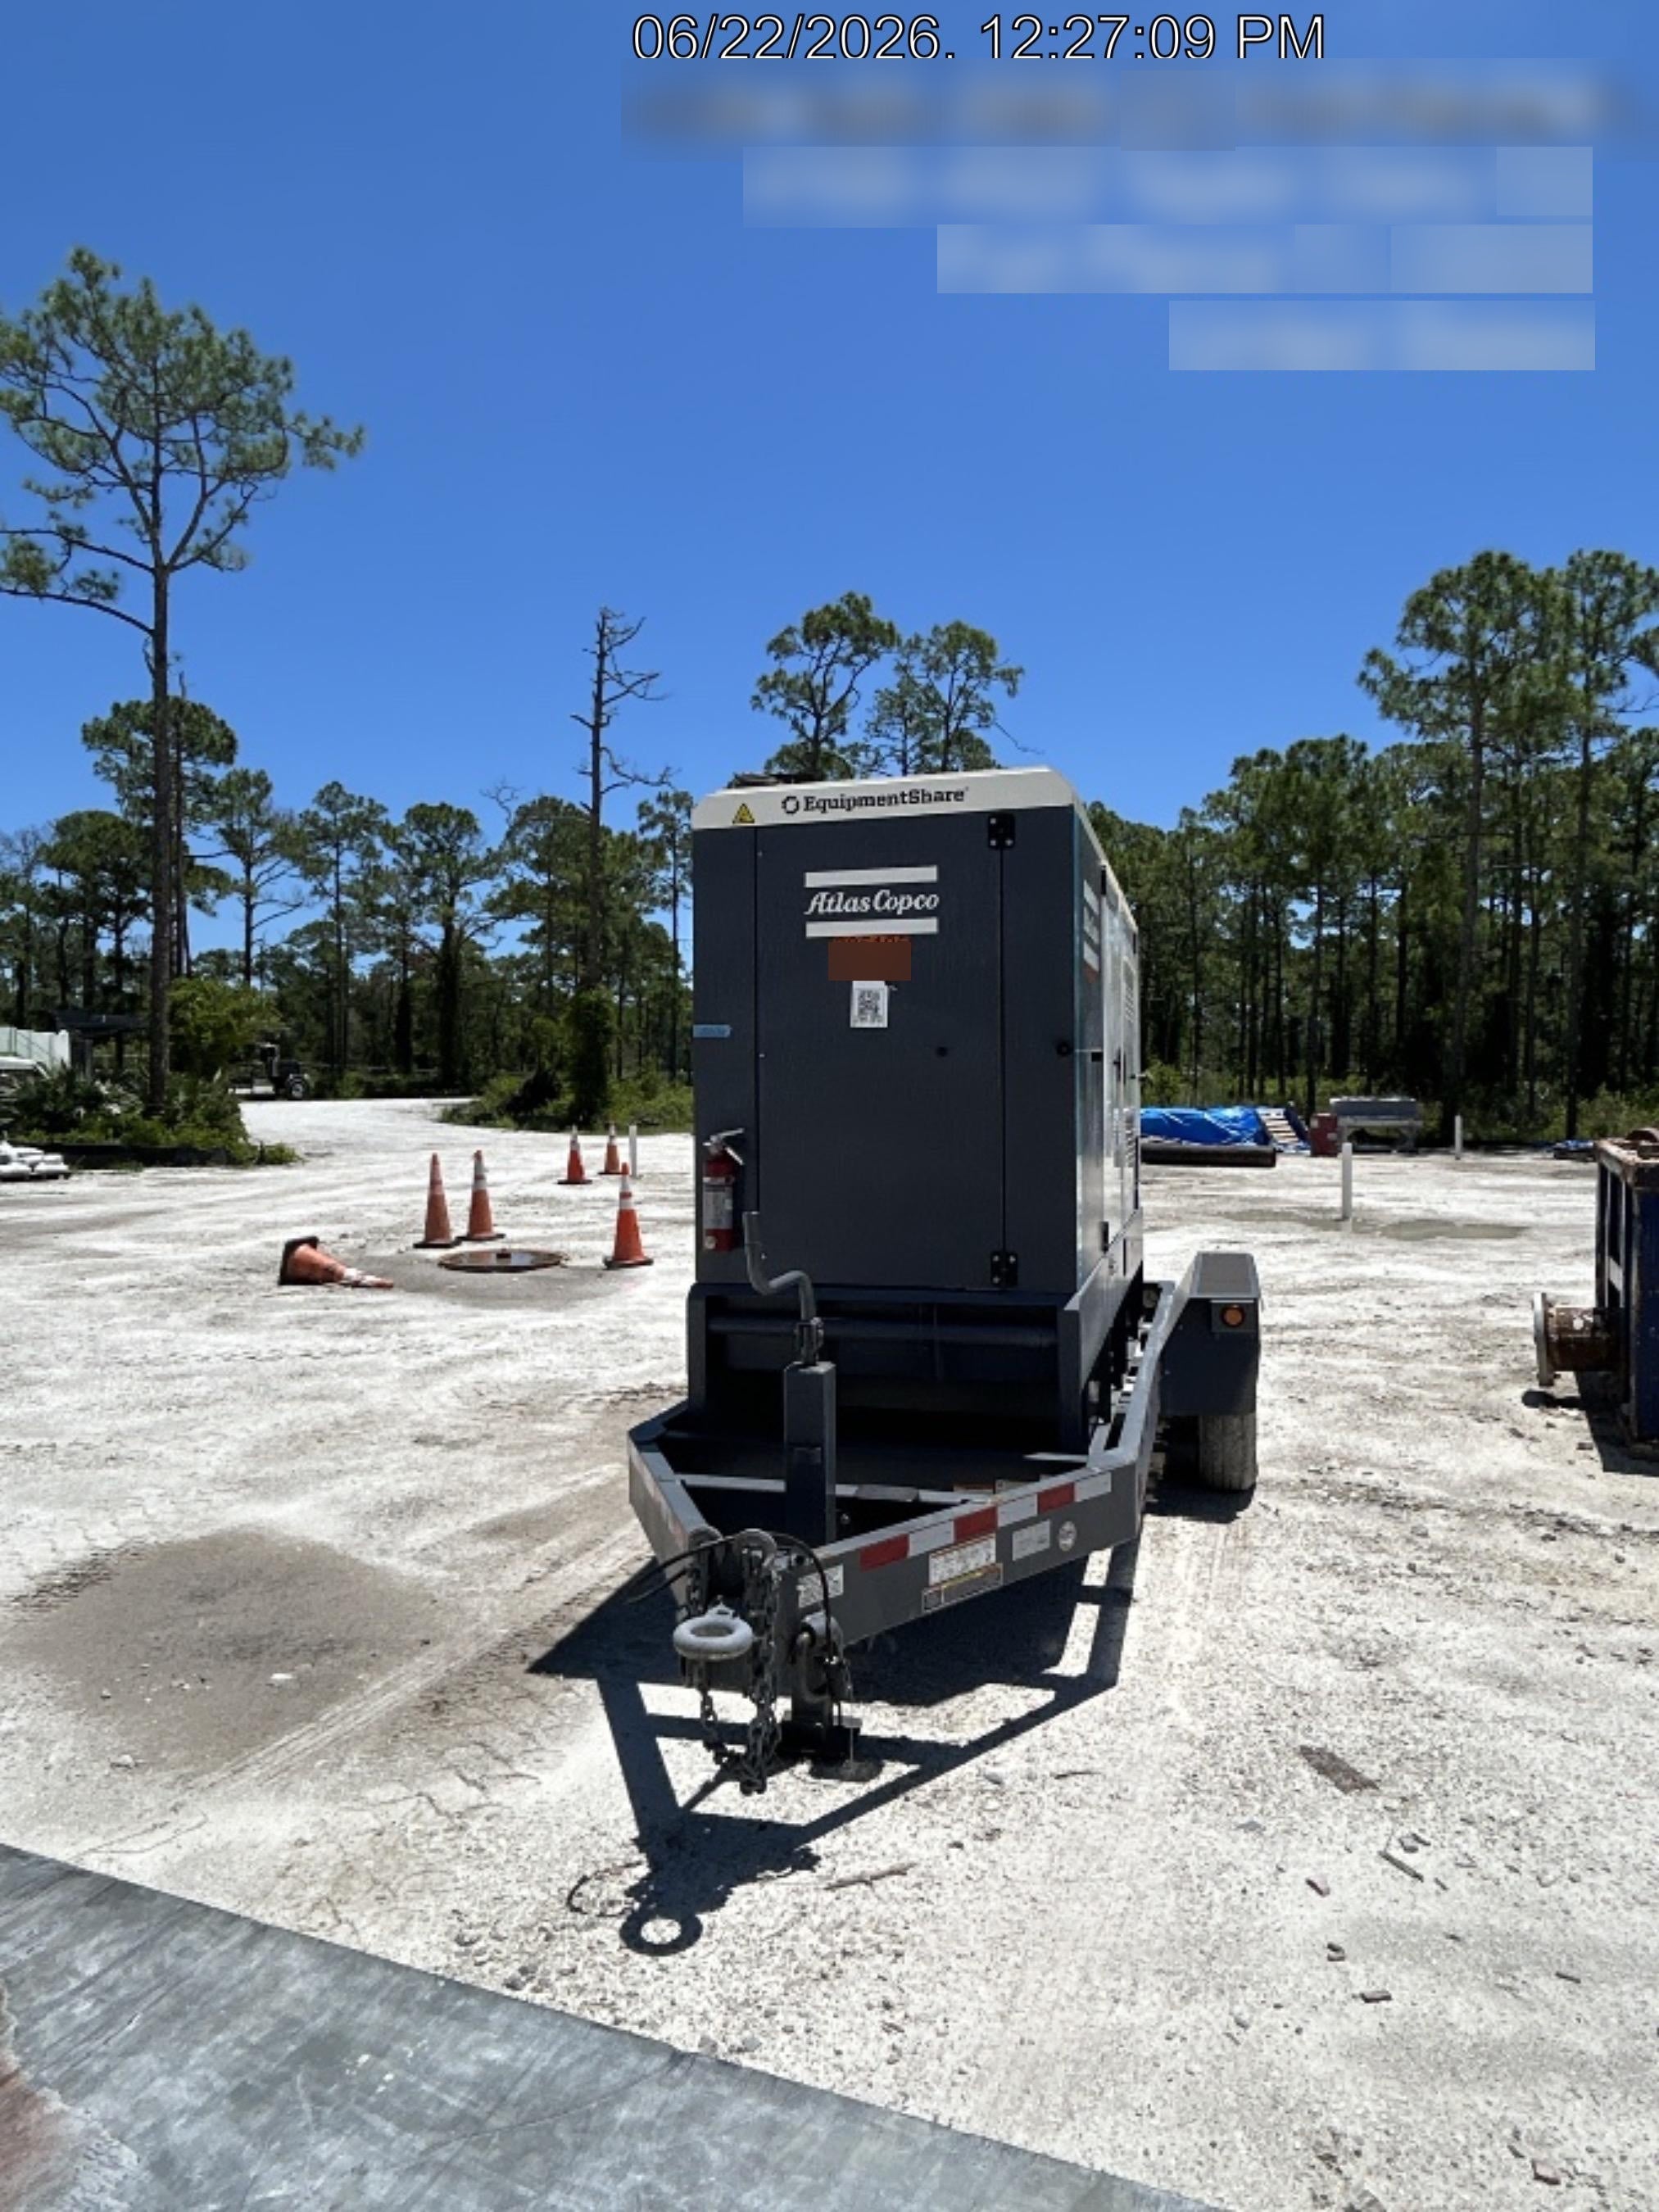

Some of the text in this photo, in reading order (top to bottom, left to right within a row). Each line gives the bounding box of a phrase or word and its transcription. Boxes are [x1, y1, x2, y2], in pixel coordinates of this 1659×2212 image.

[803, 787, 965, 814] EquipmentShare
[803, 889, 940, 915] Atlas Copco
